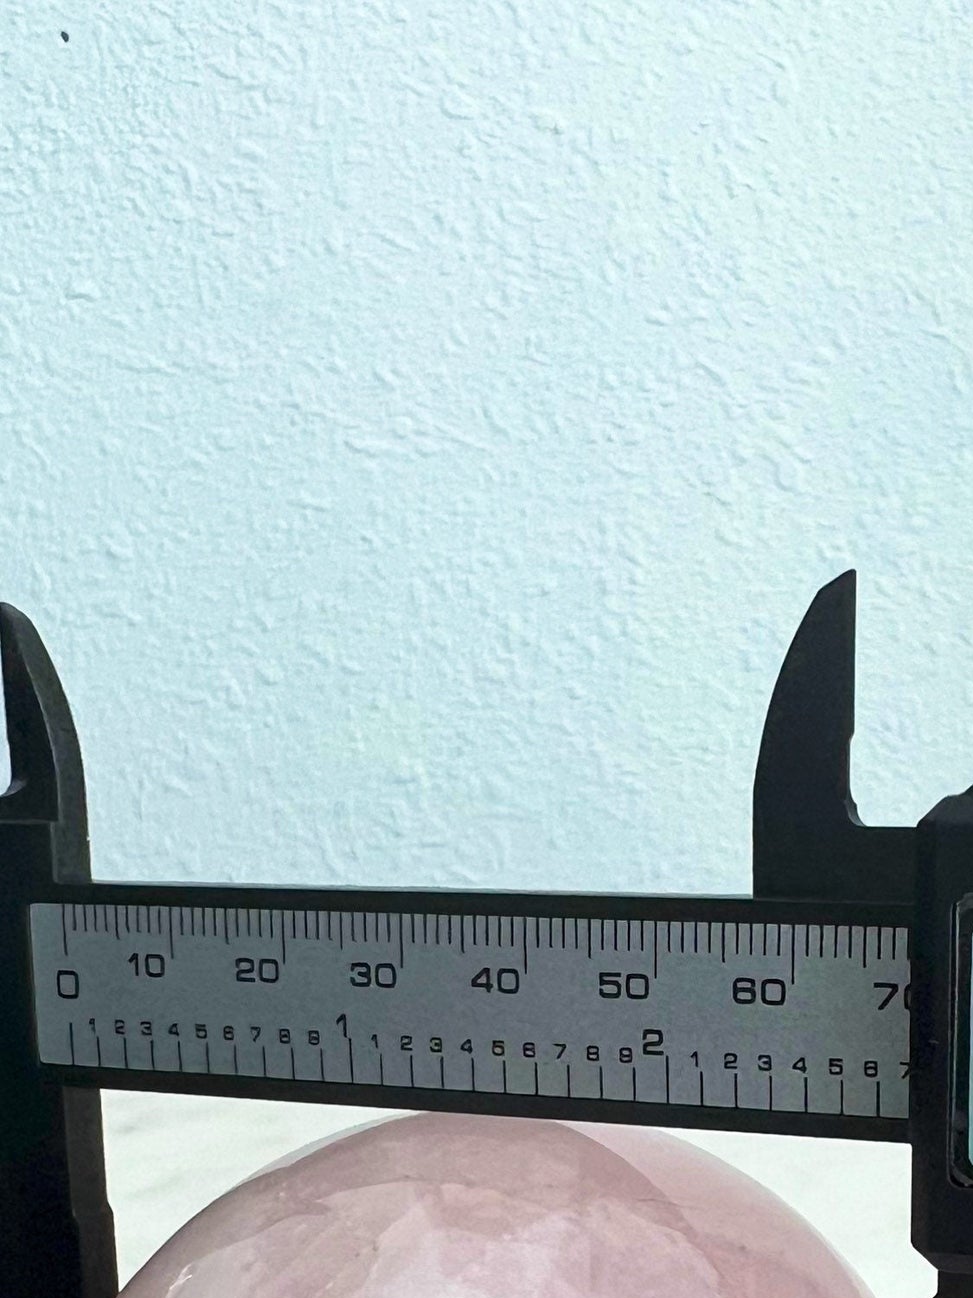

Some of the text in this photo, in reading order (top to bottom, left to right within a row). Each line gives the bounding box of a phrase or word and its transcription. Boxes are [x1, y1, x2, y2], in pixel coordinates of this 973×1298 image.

[57, 970, 79, 998] 0
[127, 953, 165, 977] 10
[235, 958, 279, 982] 20
[350, 962, 397, 987] 30
[471, 968, 520, 993] 40
[599, 972, 649, 998] 50
[732, 978, 787, 1005] 60
[89, 1018, 96, 1033] 1
[115, 1020, 125, 1033] 2
[140, 1021, 152, 1035] 3
[168, 1023, 180, 1036] 4
[195, 1024, 208, 1038] 5
[250, 1027, 261, 1041] 7
[336, 1013, 349, 1037] 1
[371, 1033, 378, 1047] 1
[400, 1035, 413, 1050] 2
[430, 1037, 443, 1052] 3
[460, 1038, 473, 1053] 4
[492, 1040, 505, 1056] 5
[553, 1043, 567, 1059] 7
[642, 1029, 664, 1055] 2
[690, 1051, 699, 1067] 1
[724, 1053, 738, 1068] 2
[758, 1055, 772, 1070] 3
[792, 1057, 807, 1072] 4
[828, 1058, 843, 1074] 5
